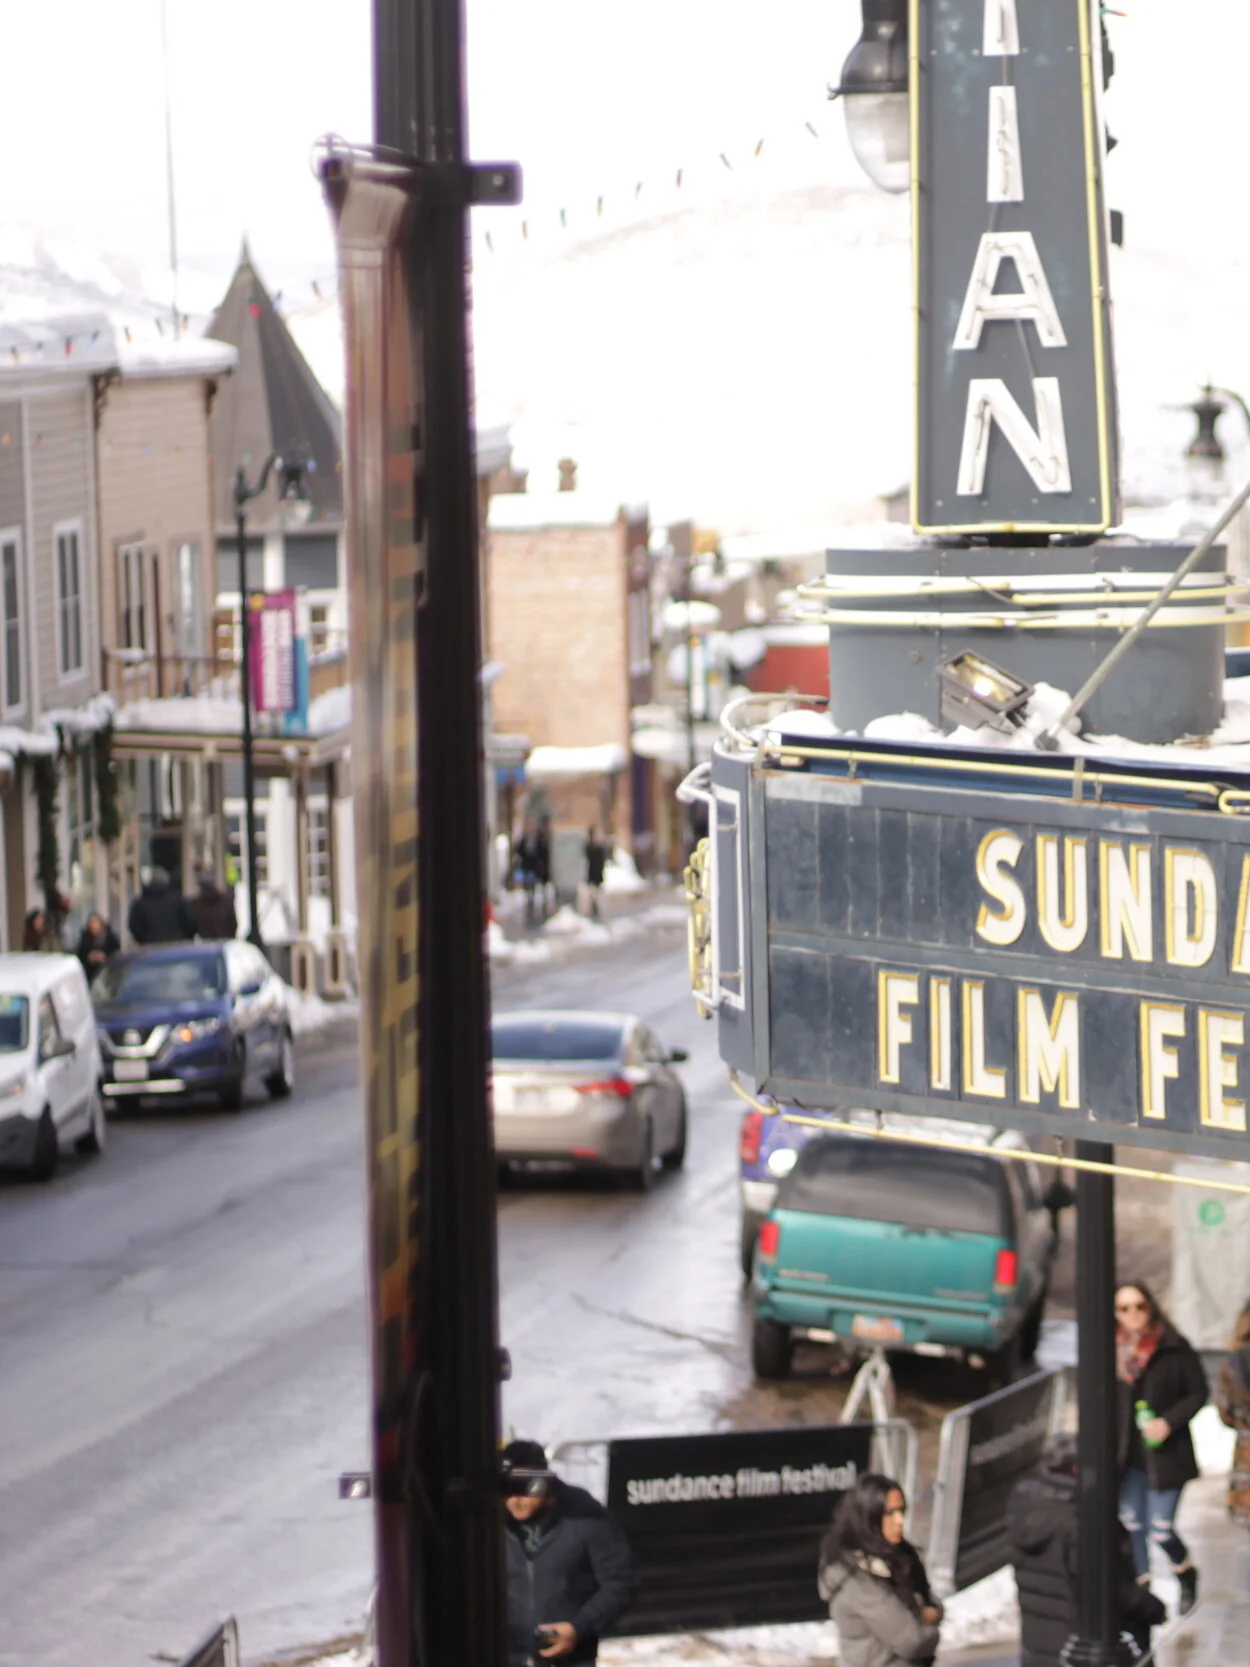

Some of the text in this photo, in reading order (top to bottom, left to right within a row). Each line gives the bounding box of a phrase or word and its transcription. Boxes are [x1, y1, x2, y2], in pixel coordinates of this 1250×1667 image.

[877, 969, 1081, 1109] FILM
[626, 1460, 857, 1505] sundance film festival
